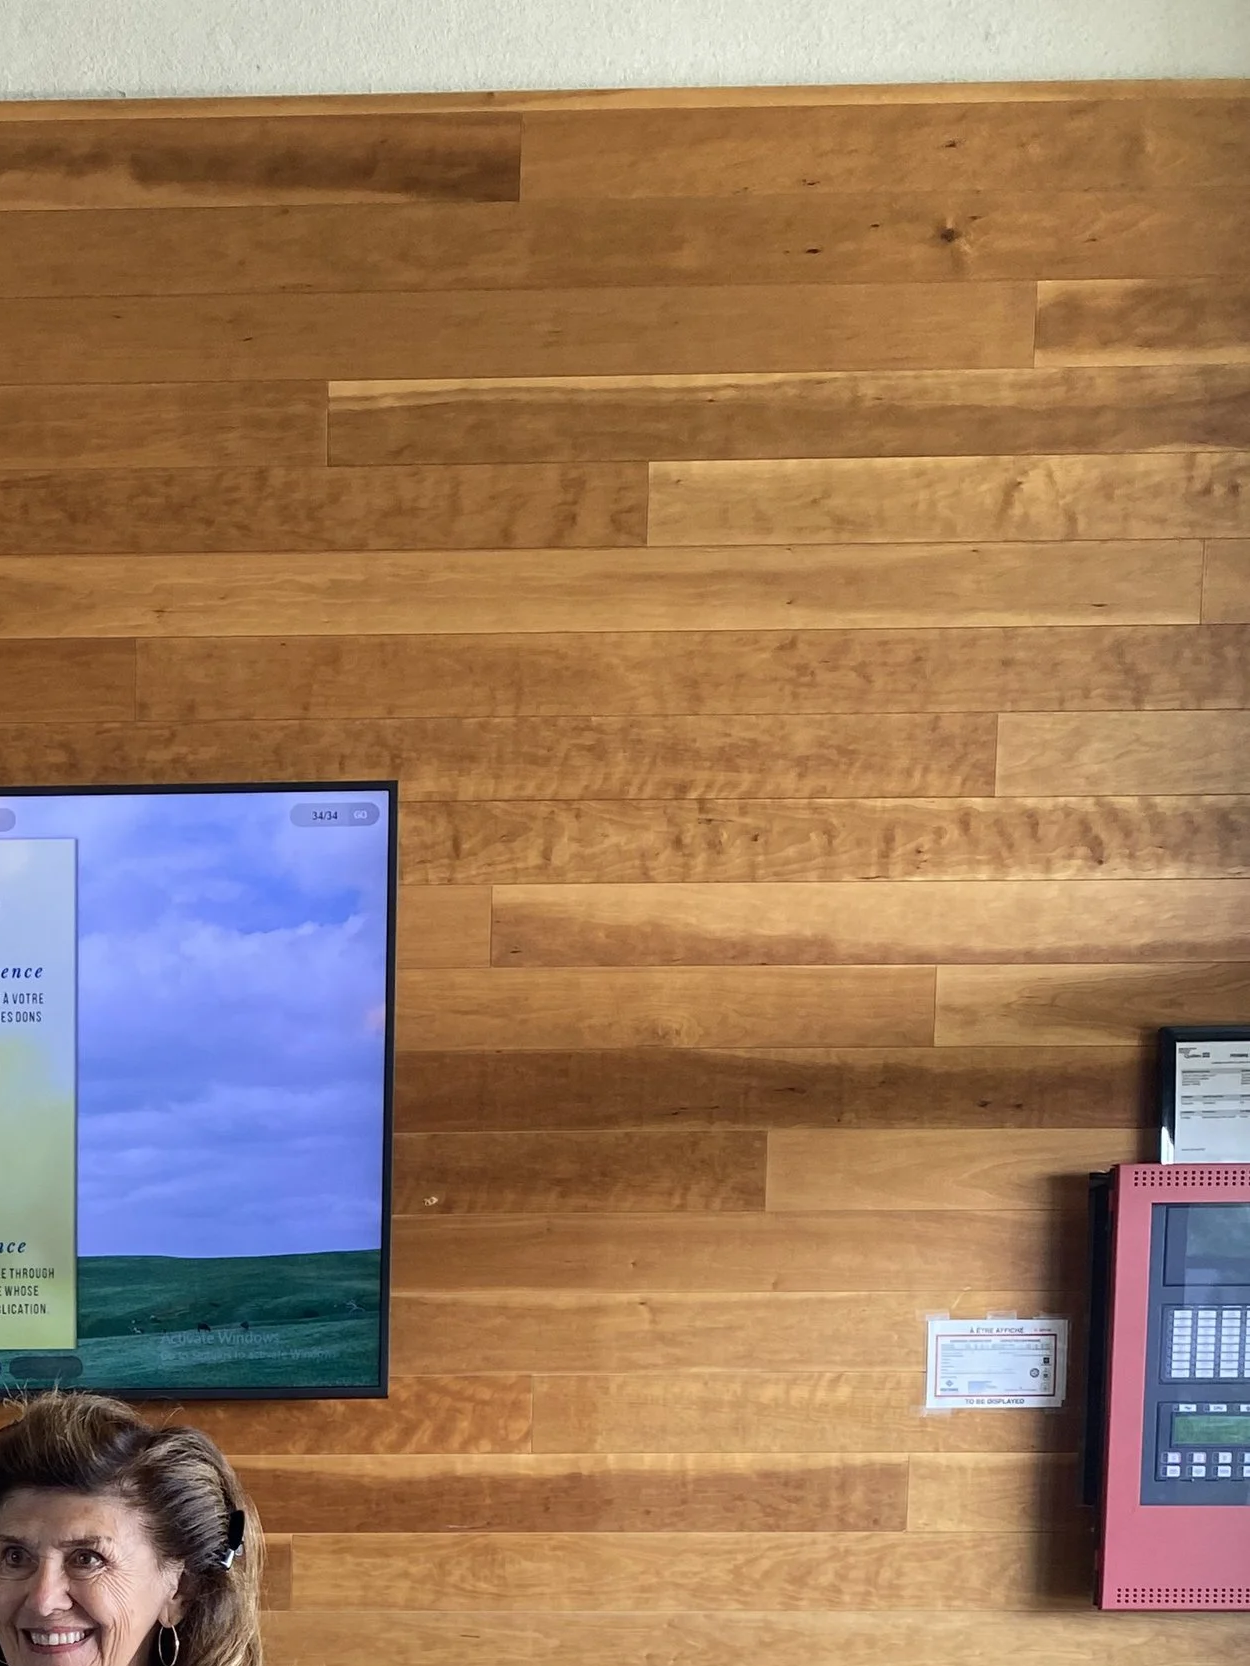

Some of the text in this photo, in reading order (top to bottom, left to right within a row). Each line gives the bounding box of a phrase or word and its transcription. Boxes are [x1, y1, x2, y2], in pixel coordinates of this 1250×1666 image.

[312, 811, 338, 820] 34/34
[3, 992, 9, 1004] À
[12, 993, 44, 1004] VOTRE
[16, 1011, 41, 1022] DONS
[9, 1268, 54, 1279] THROUGH
[4, 1285, 38, 1296] WHOSE
